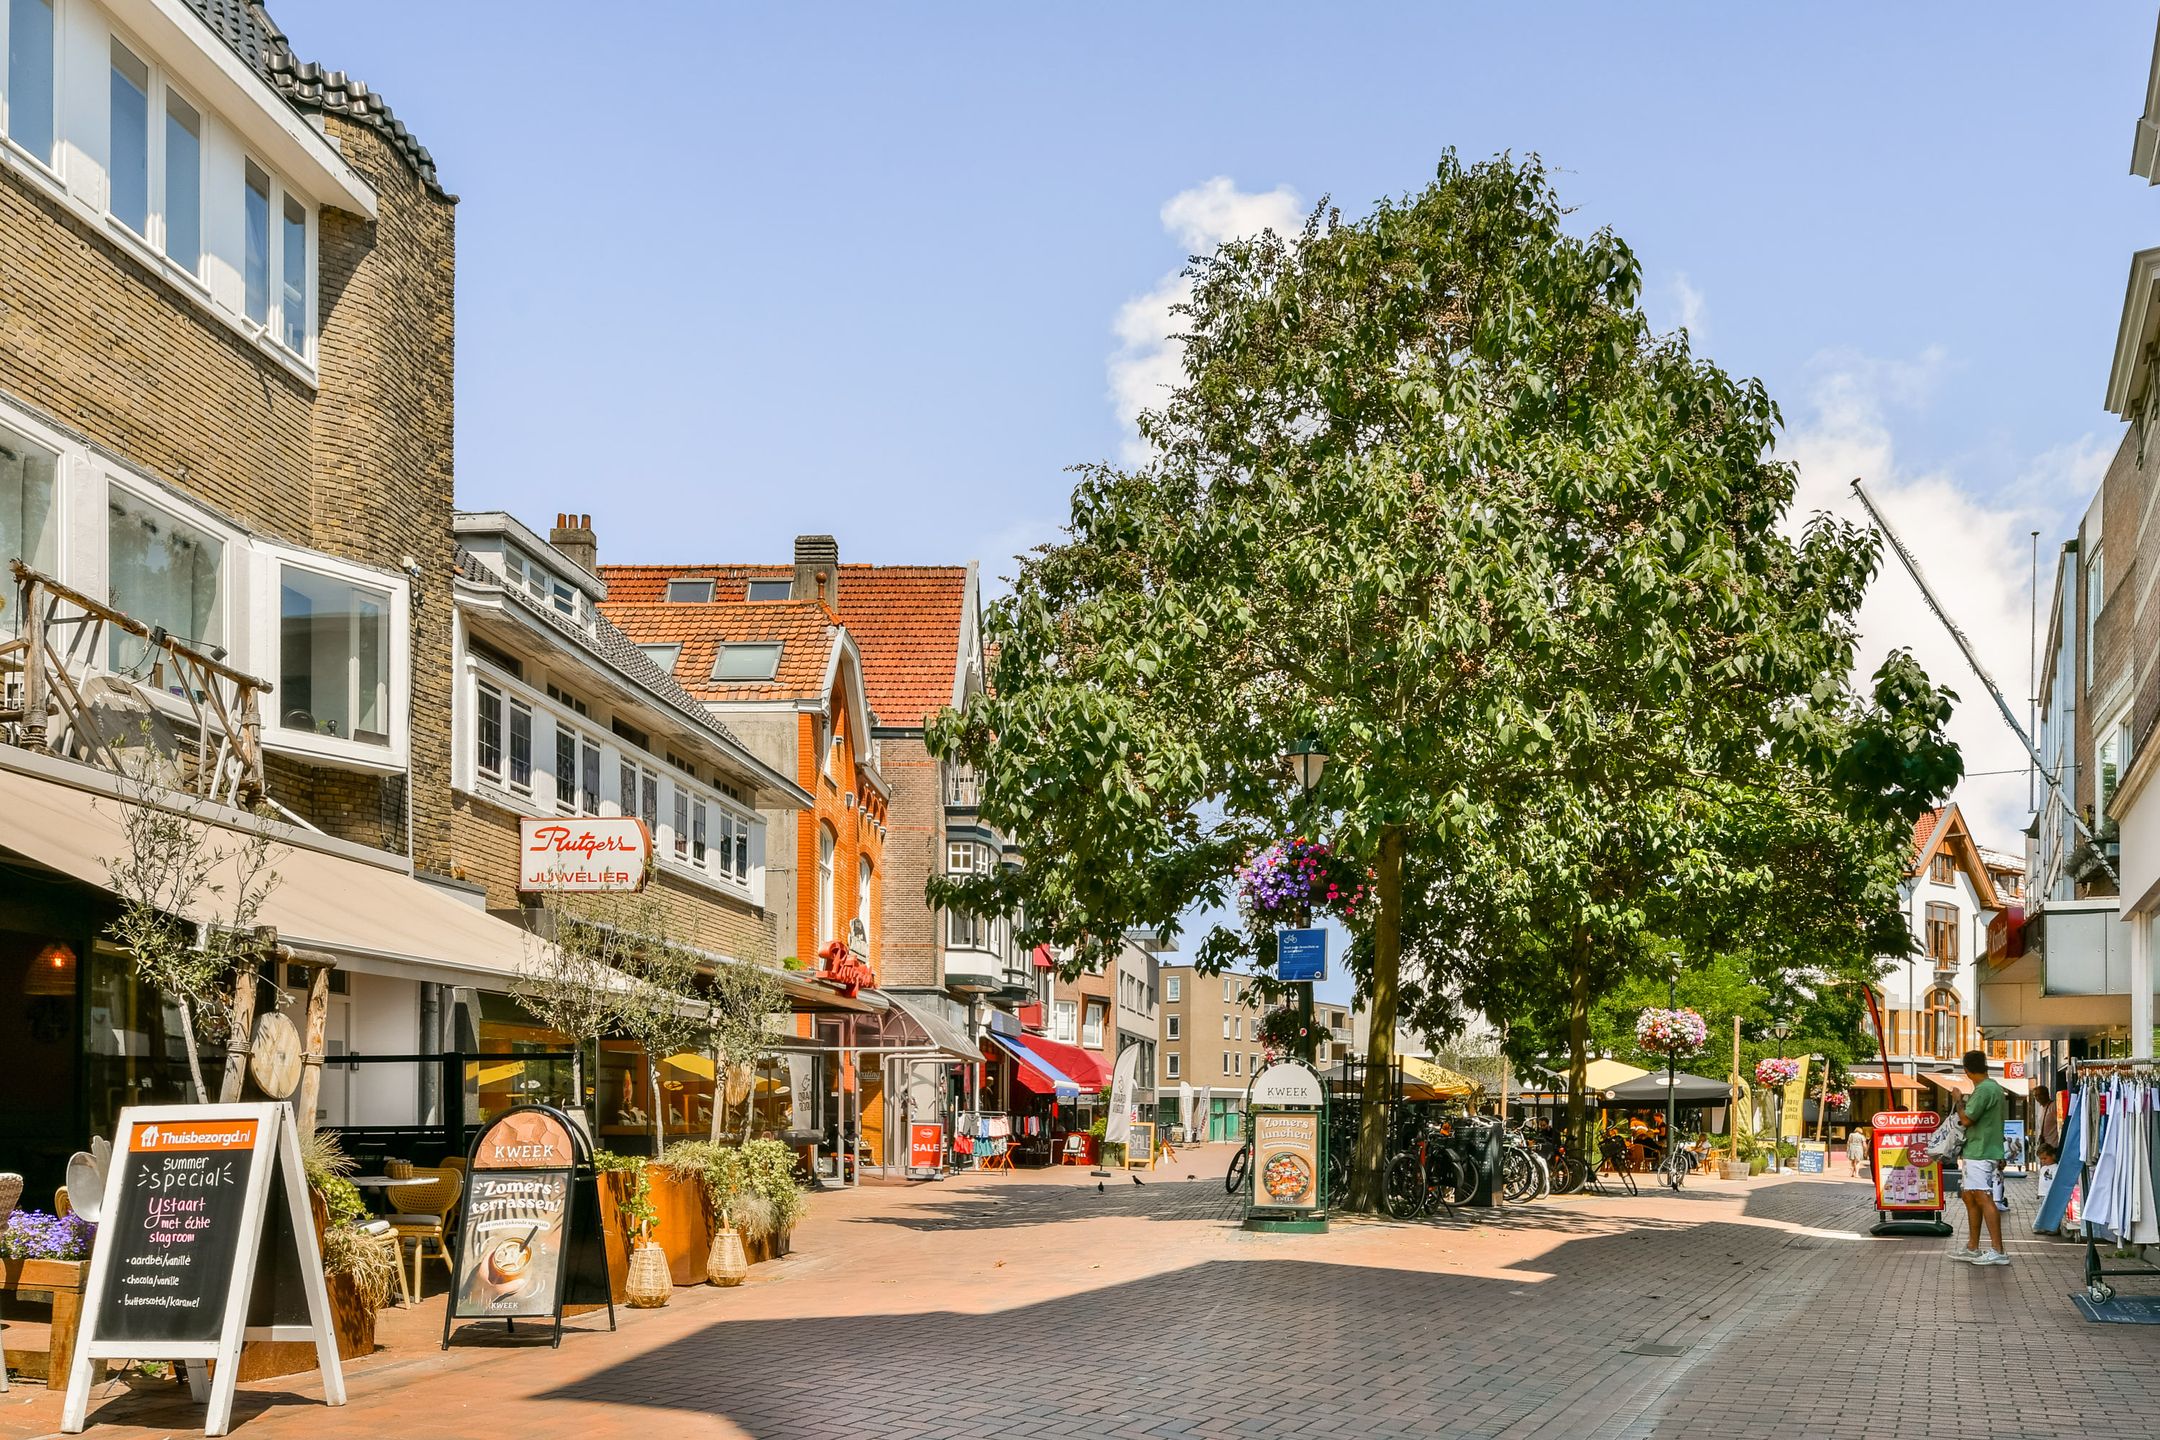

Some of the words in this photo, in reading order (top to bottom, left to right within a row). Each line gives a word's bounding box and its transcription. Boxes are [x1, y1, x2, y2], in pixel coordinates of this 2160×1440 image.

[529, 825, 637, 860] Rutgers
[528, 872, 629, 883] JUWELIER
[1267, 1087, 1308, 1096] KWEEK
[1264, 1117, 1309, 1129] Zomers
[1888, 1115, 1935, 1125] Kruidvat
[161, 1130, 250, 1146] Thuisbezorgd.nl
[1261, 1128, 1313, 1140] lunchen!
[913, 1143, 939, 1152] SALE
[1130, 1133, 1151, 1150] SALE
[494, 1145, 553, 1158] KWEEK
[163, 1157, 209, 1171] summer
[149, 1167, 220, 1192] special
[483, 1181, 552, 1196] Zomers
[471, 1198, 561, 1214] terrassen!
[161, 1217, 181, 1229] met
[184, 1215, 211, 1229] échte
[149, 1231, 195, 1248] slagroom
[126, 1274, 180, 1287] chocola/vanille
[124, 1293, 200, 1309] butterscotch/karamel
